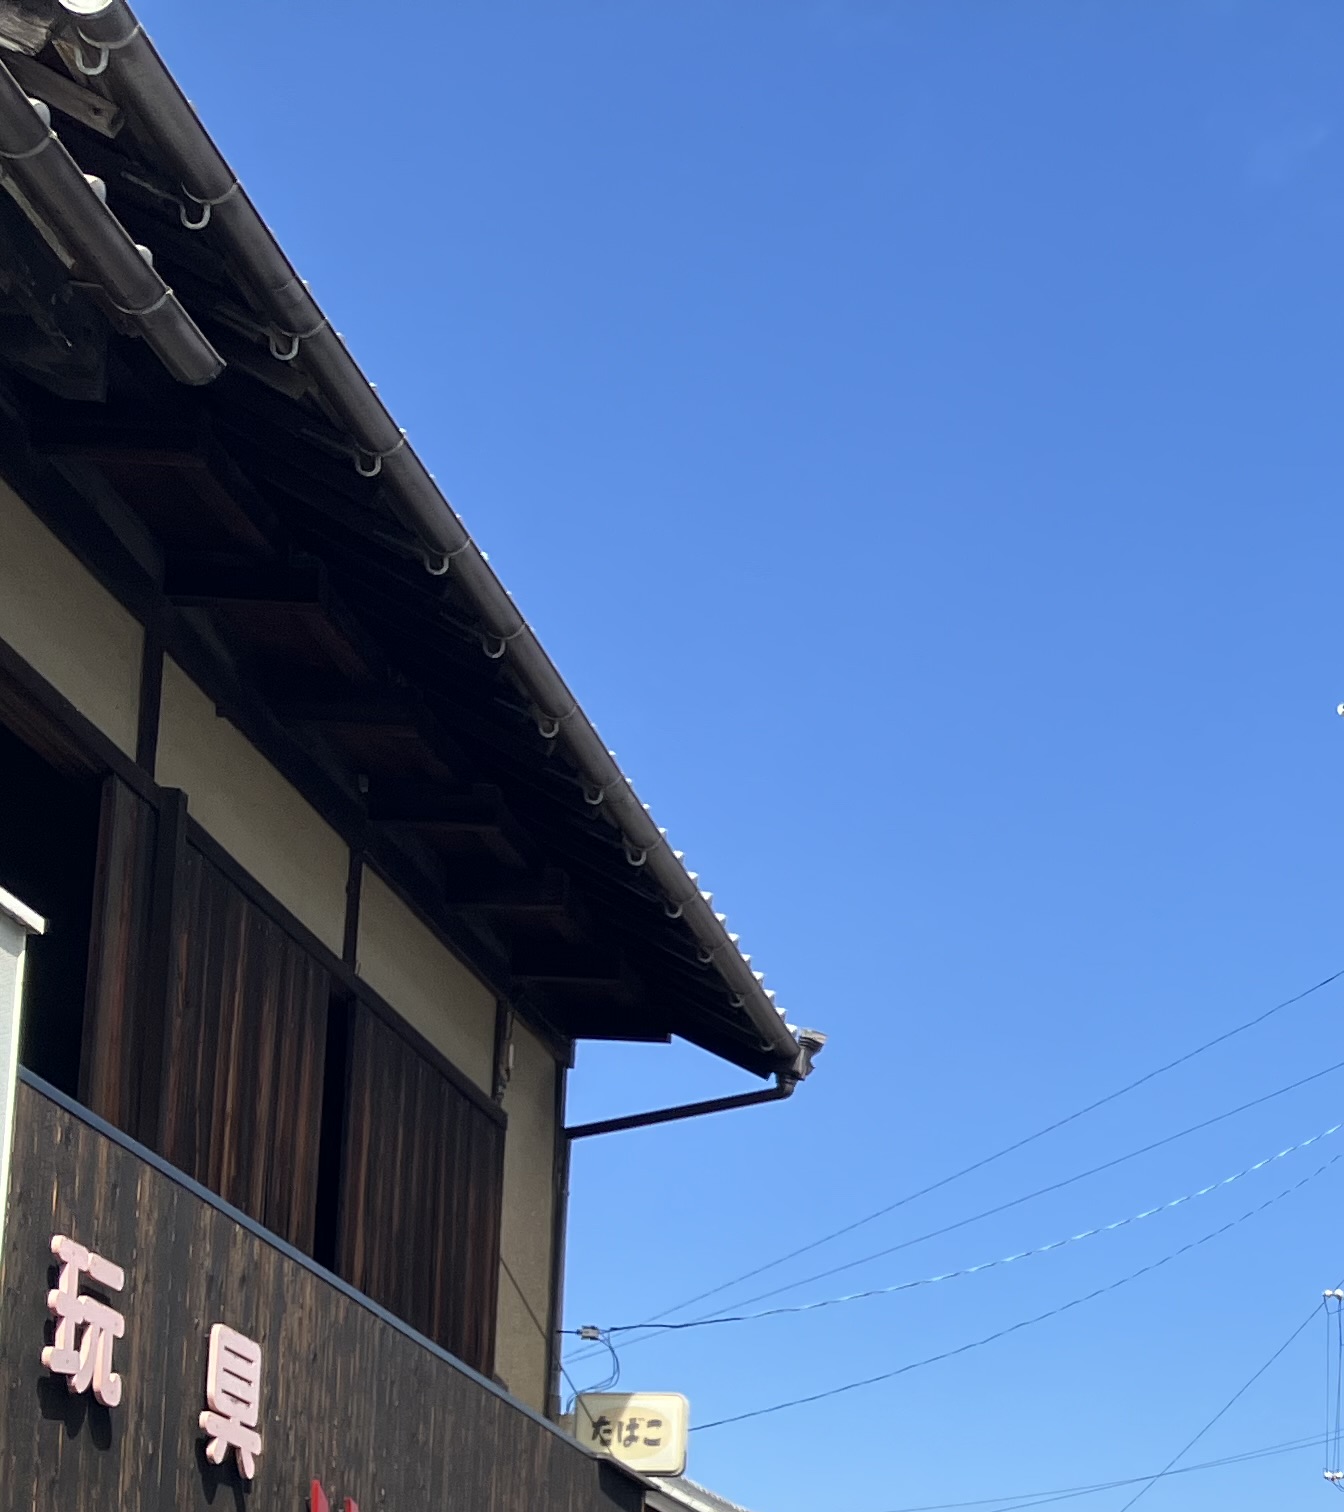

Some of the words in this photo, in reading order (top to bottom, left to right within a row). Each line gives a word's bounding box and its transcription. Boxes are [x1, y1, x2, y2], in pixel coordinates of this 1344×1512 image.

[41, 1234, 263, 1480] 玩具
[590, 1417, 663, 1448] たばこ
